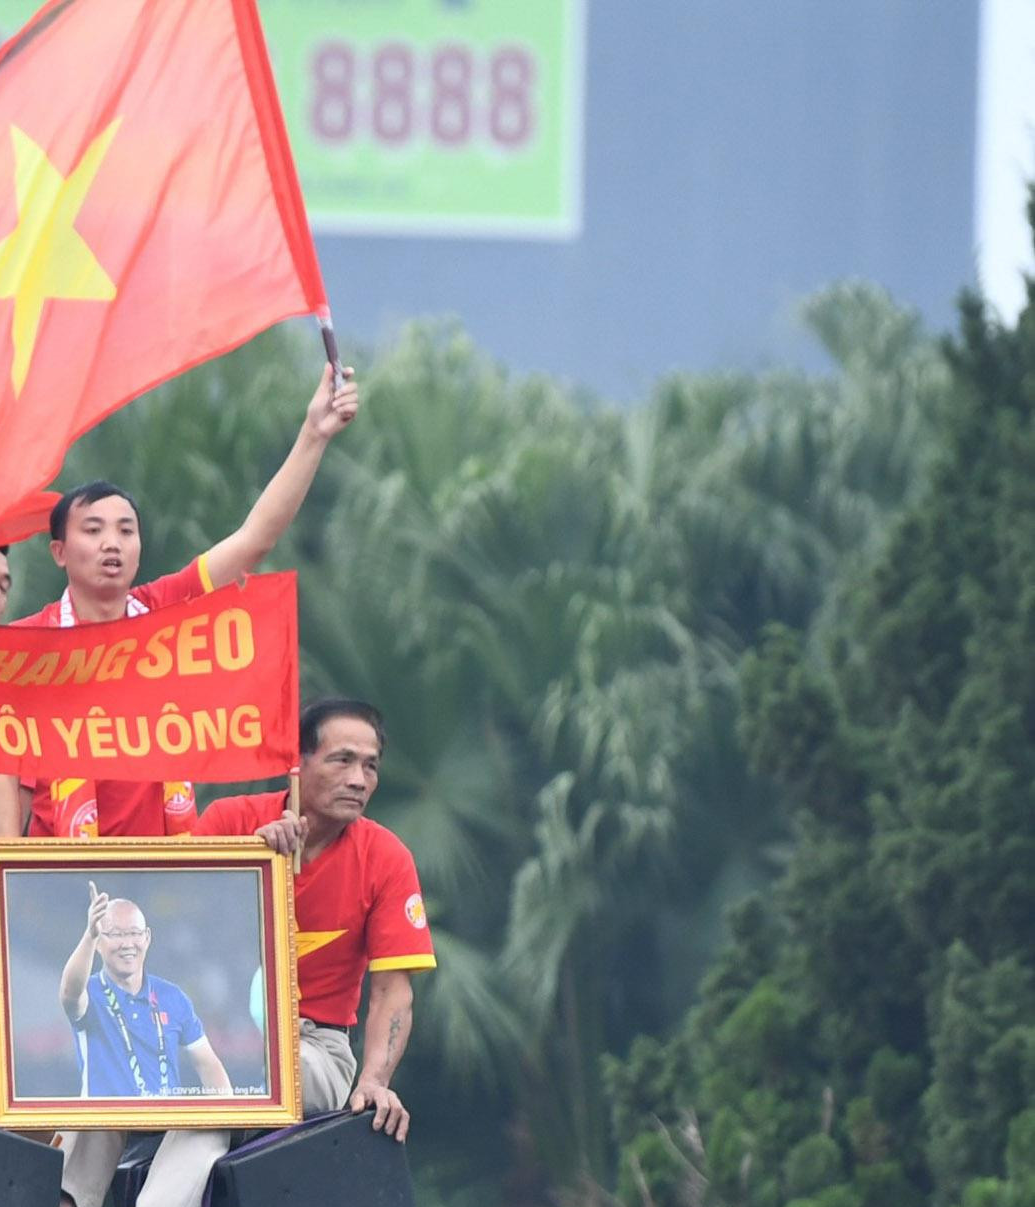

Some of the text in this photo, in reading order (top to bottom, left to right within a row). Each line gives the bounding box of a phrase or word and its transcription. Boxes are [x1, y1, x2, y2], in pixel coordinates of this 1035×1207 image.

[309, 40, 536, 148] 8888
[136, 608, 255, 679] SEO
[51, 706, 153, 759] YÊU
[155, 702, 262, 755] ÔNG
